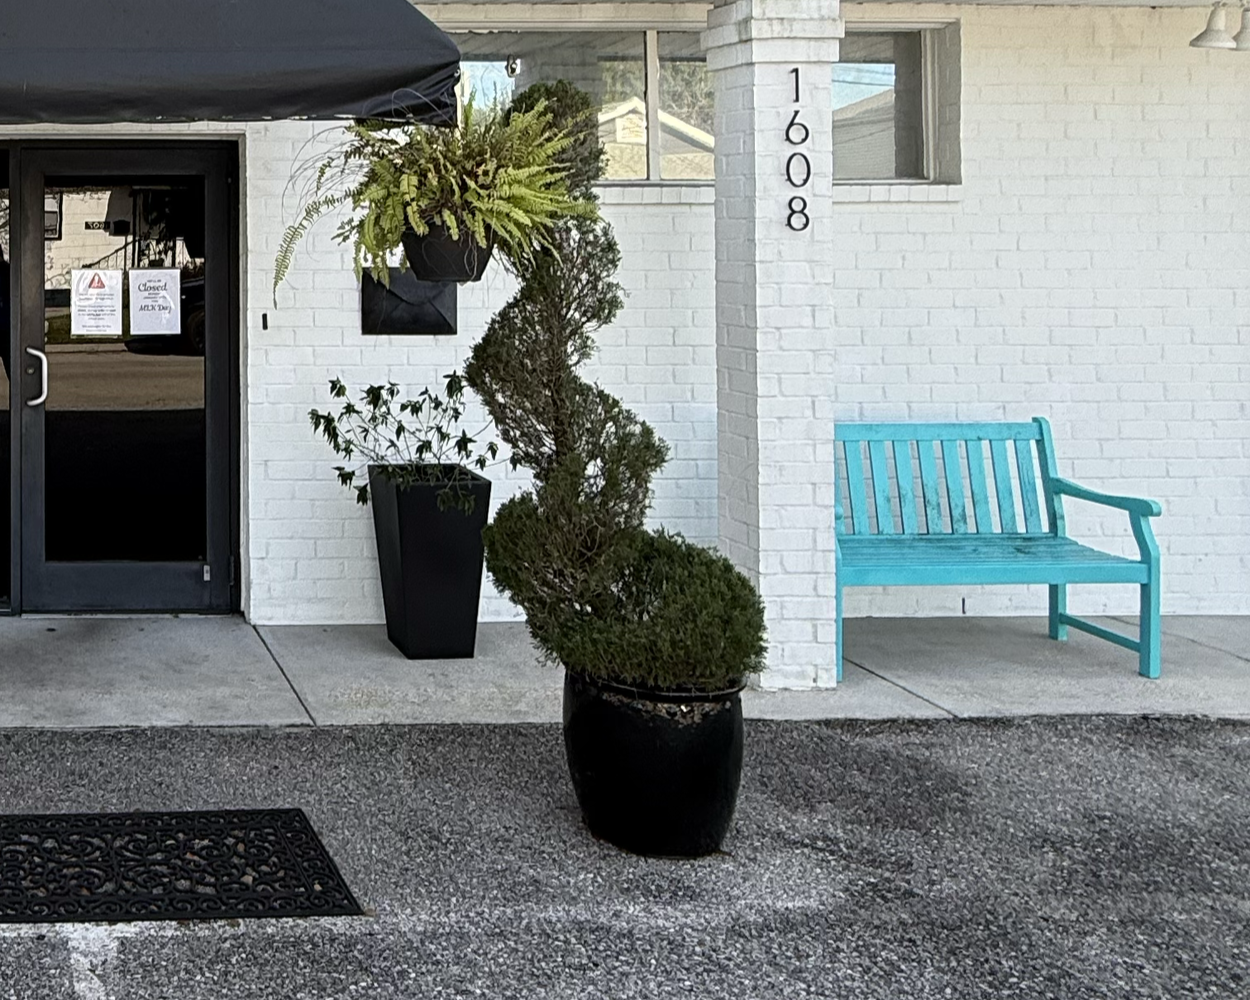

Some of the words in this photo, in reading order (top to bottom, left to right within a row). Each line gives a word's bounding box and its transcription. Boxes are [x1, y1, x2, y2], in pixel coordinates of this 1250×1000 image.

[784, 67, 812, 232] 1608
[137, 281, 168, 292] Closed
[138, 304, 156, 312] MLK
[156, 304, 171, 314] Day
